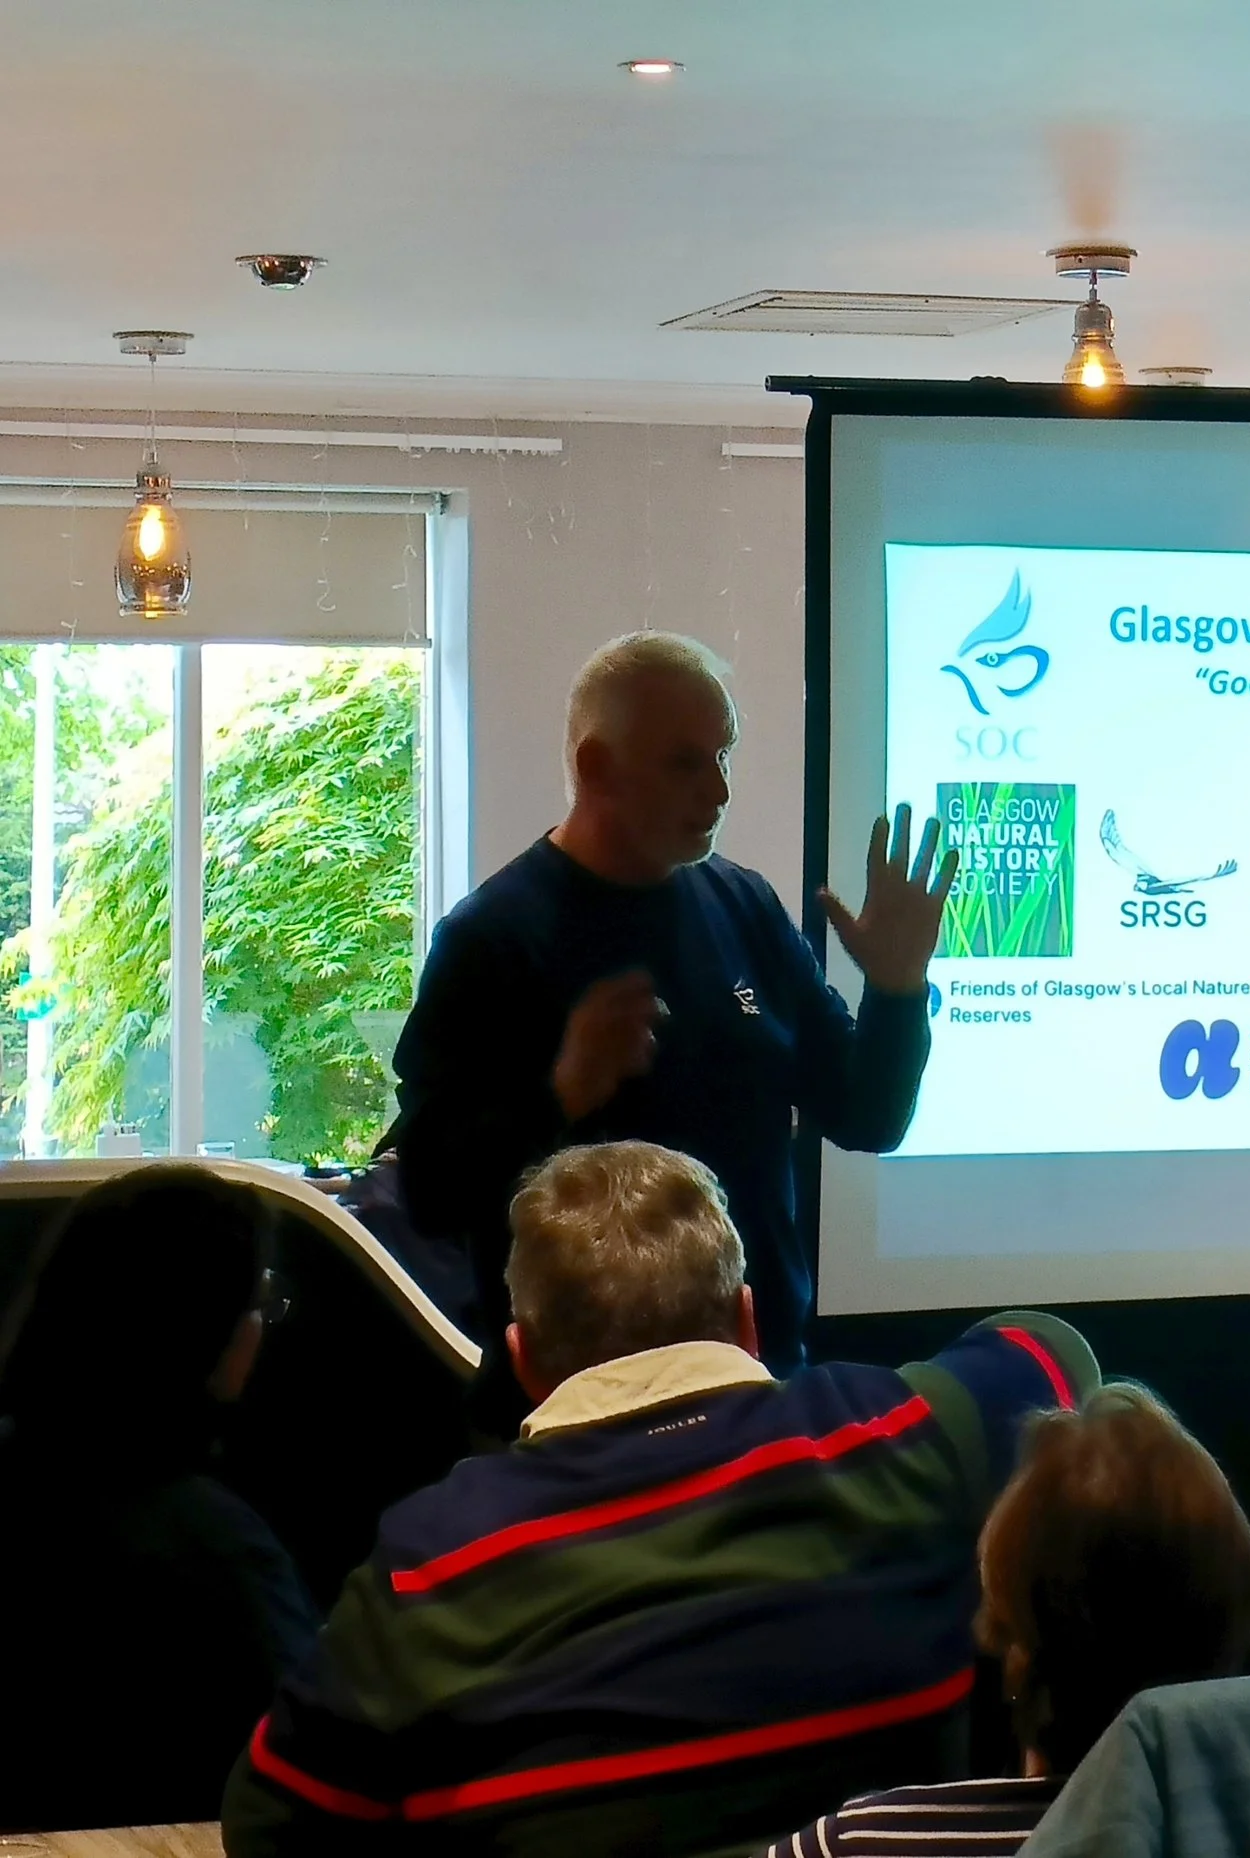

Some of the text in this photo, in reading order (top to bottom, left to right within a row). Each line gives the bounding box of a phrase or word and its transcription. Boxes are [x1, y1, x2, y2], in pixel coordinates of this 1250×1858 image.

[954, 726, 1040, 762] SOC
[947, 797, 1060, 822] GLASGOW
[947, 823, 1060, 847] NATURAL
[1120, 900, 1207, 929] SRSG
[950, 980, 1016, 997] Friends
[1021, 980, 1039, 997] of
[1141, 979, 1188, 996] Local
[1192, 979, 1250, 996] Nature
[949, 1006, 1032, 1024] Reserves
